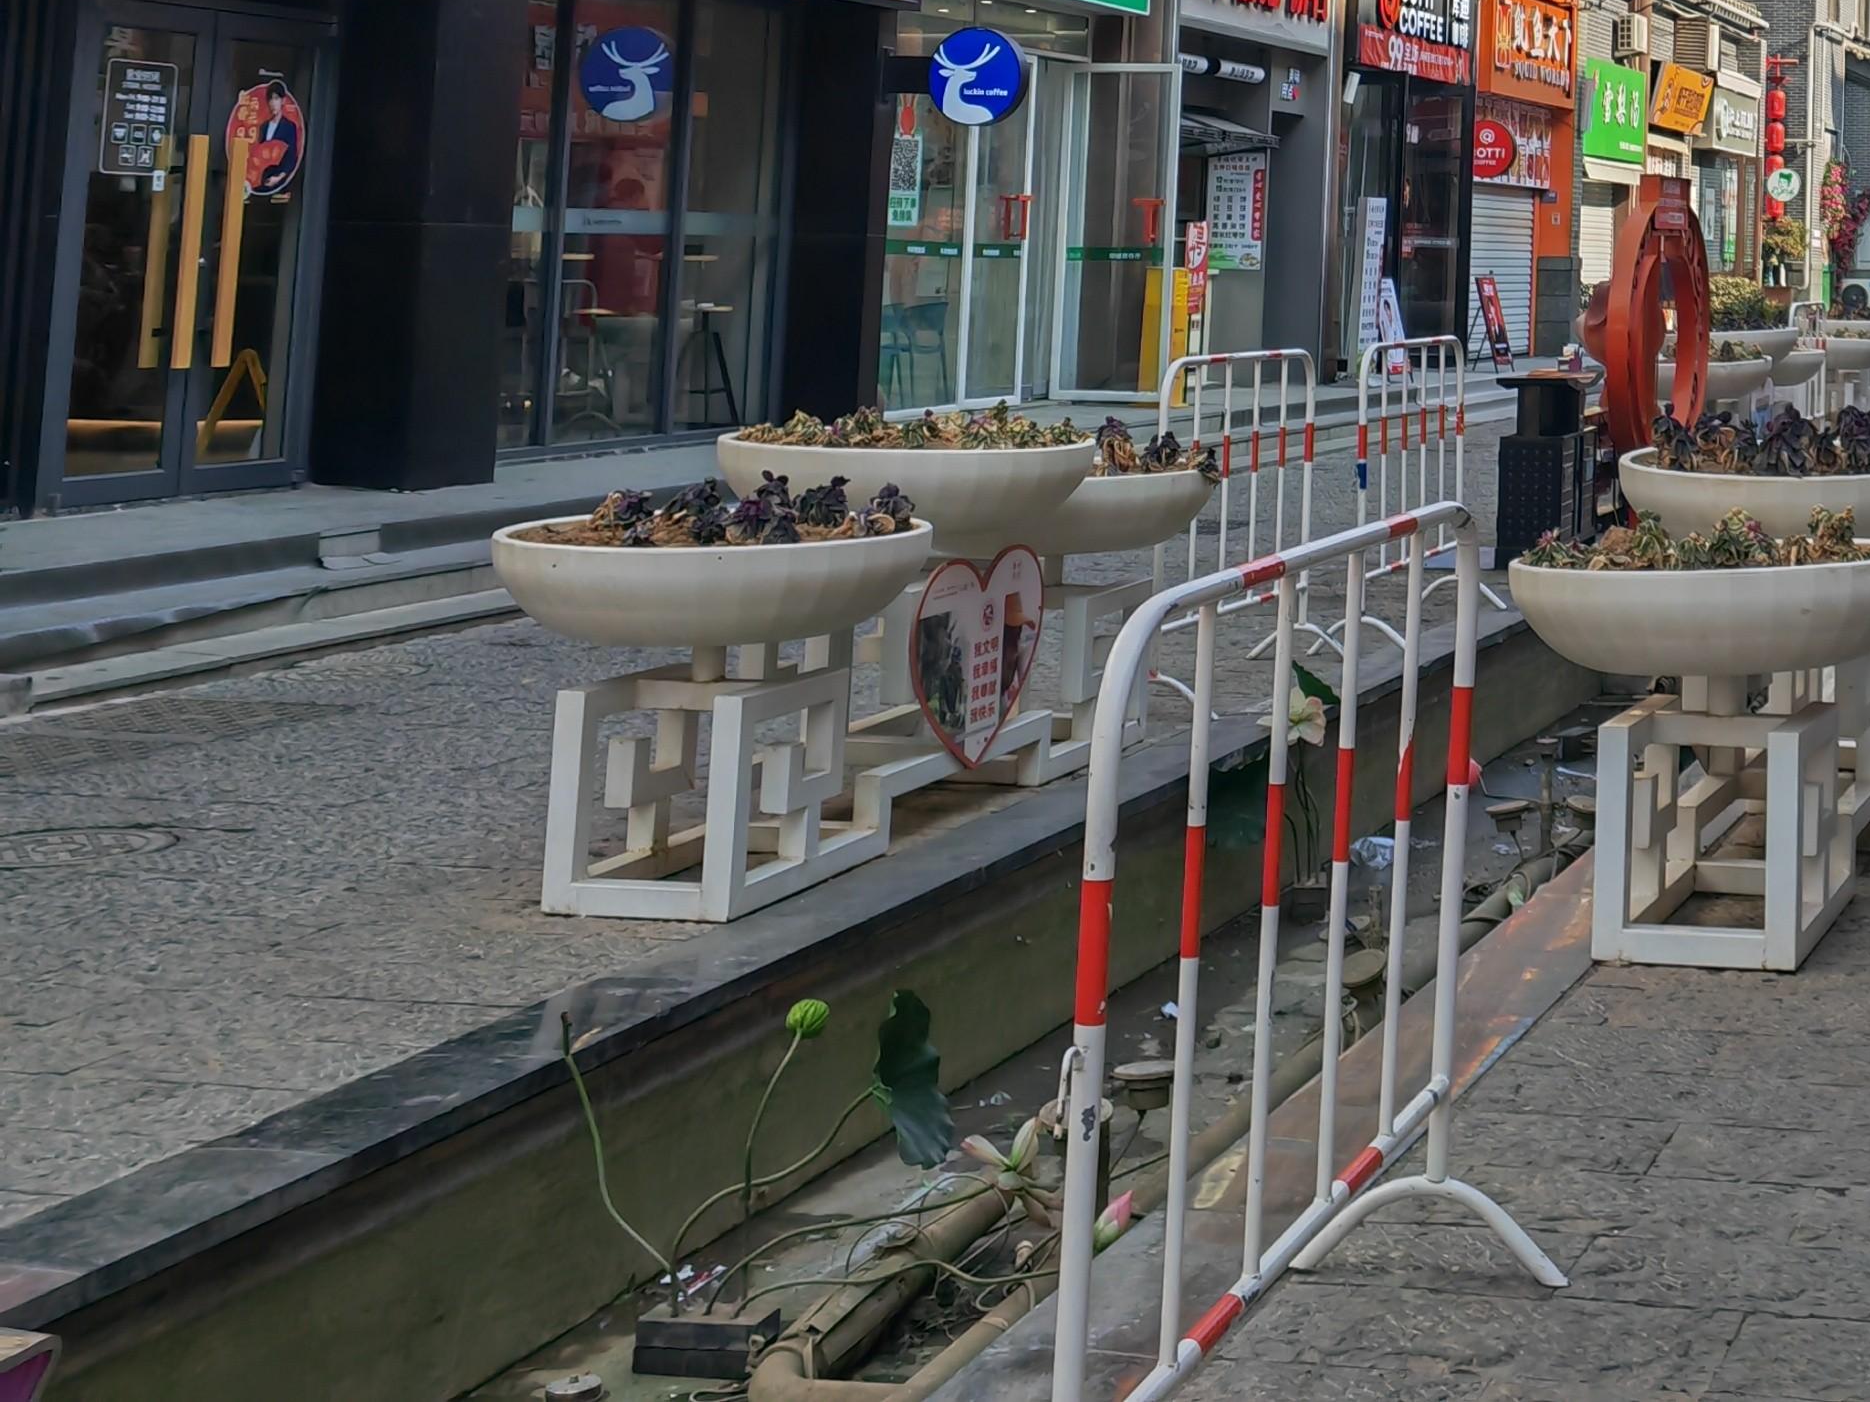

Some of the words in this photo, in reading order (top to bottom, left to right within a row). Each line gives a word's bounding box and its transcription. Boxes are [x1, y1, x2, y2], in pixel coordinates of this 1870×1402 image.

[1400, 6, 1444, 42] COFFEE
[963, 87, 985, 96] luckin
[985, 88, 1009, 97] coffee
